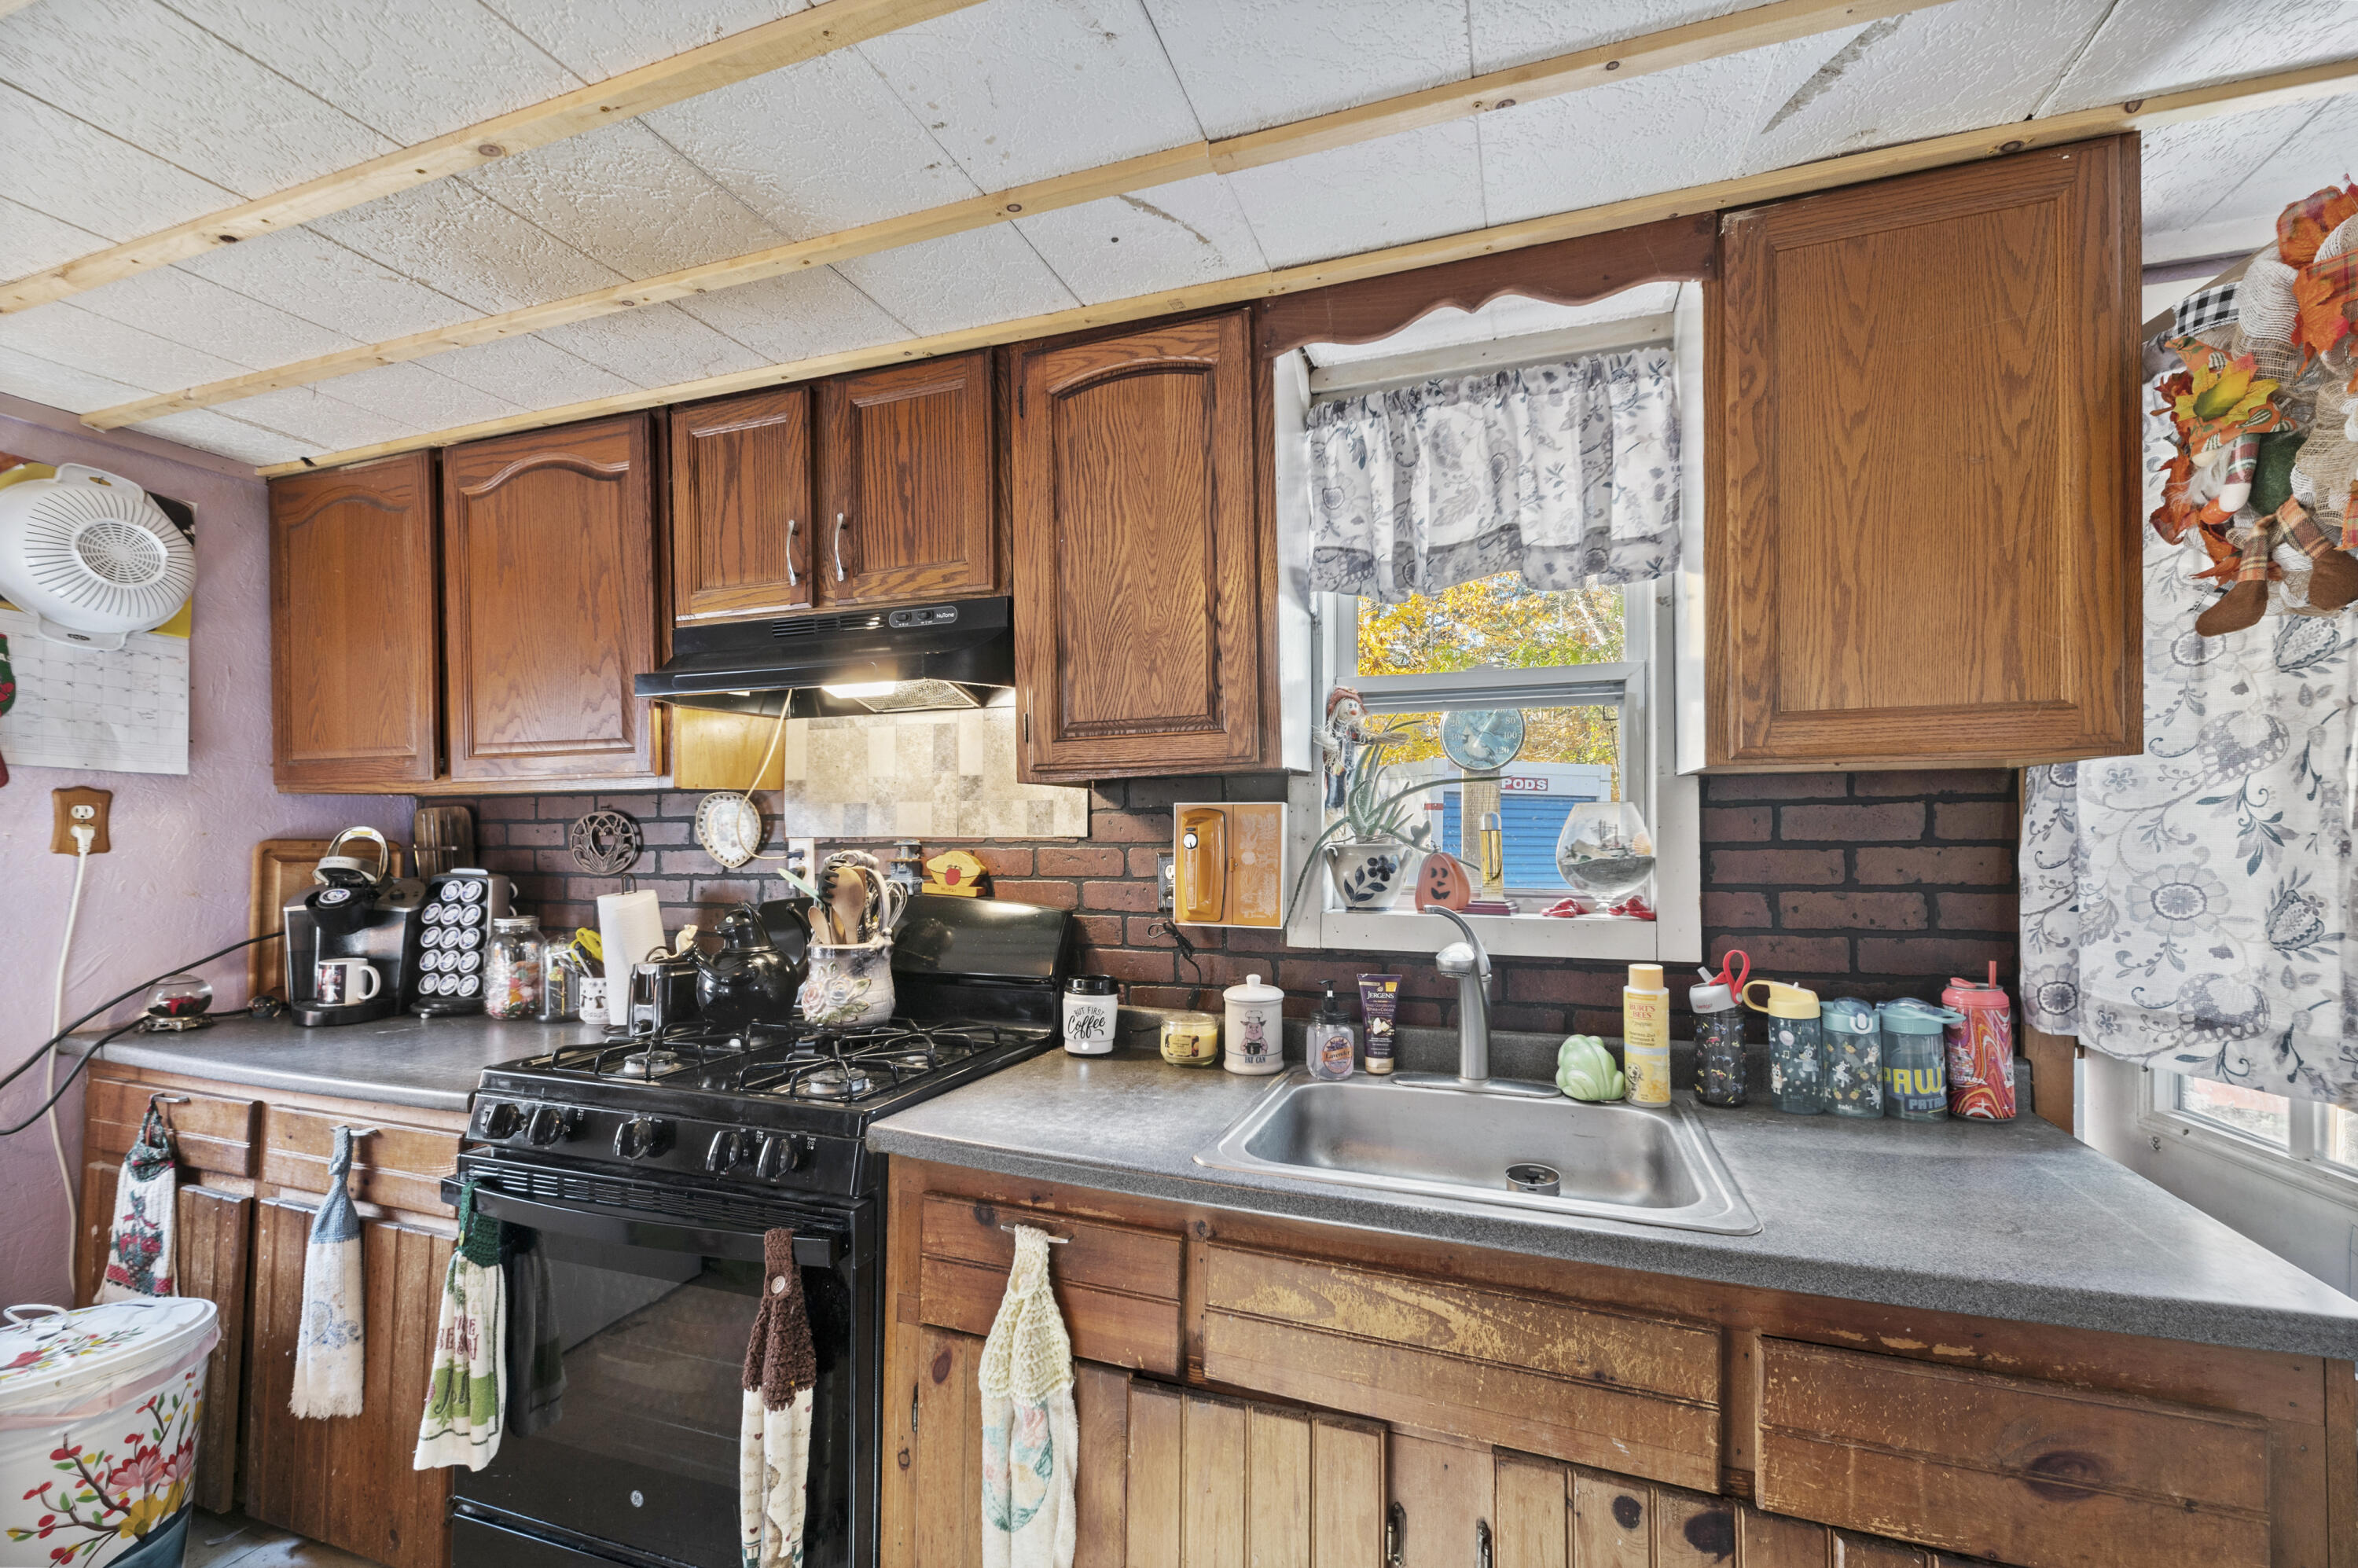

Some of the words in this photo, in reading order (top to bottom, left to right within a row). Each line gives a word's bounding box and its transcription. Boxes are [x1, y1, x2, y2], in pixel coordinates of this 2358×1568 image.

[1505, 716, 1515, 725] 80
[1495, 746, 1510, 755] 120
[1501, 778, 1547, 790] PODS
[1367, 990, 1395, 1000] JERGENS
[1074, 1007, 1085, 1017] BUT
[1087, 1006, 1105, 1017] FIRST
[1629, 1003, 1656, 1012] BURT'S
[1067, 1015, 1106, 1039] Coffee
